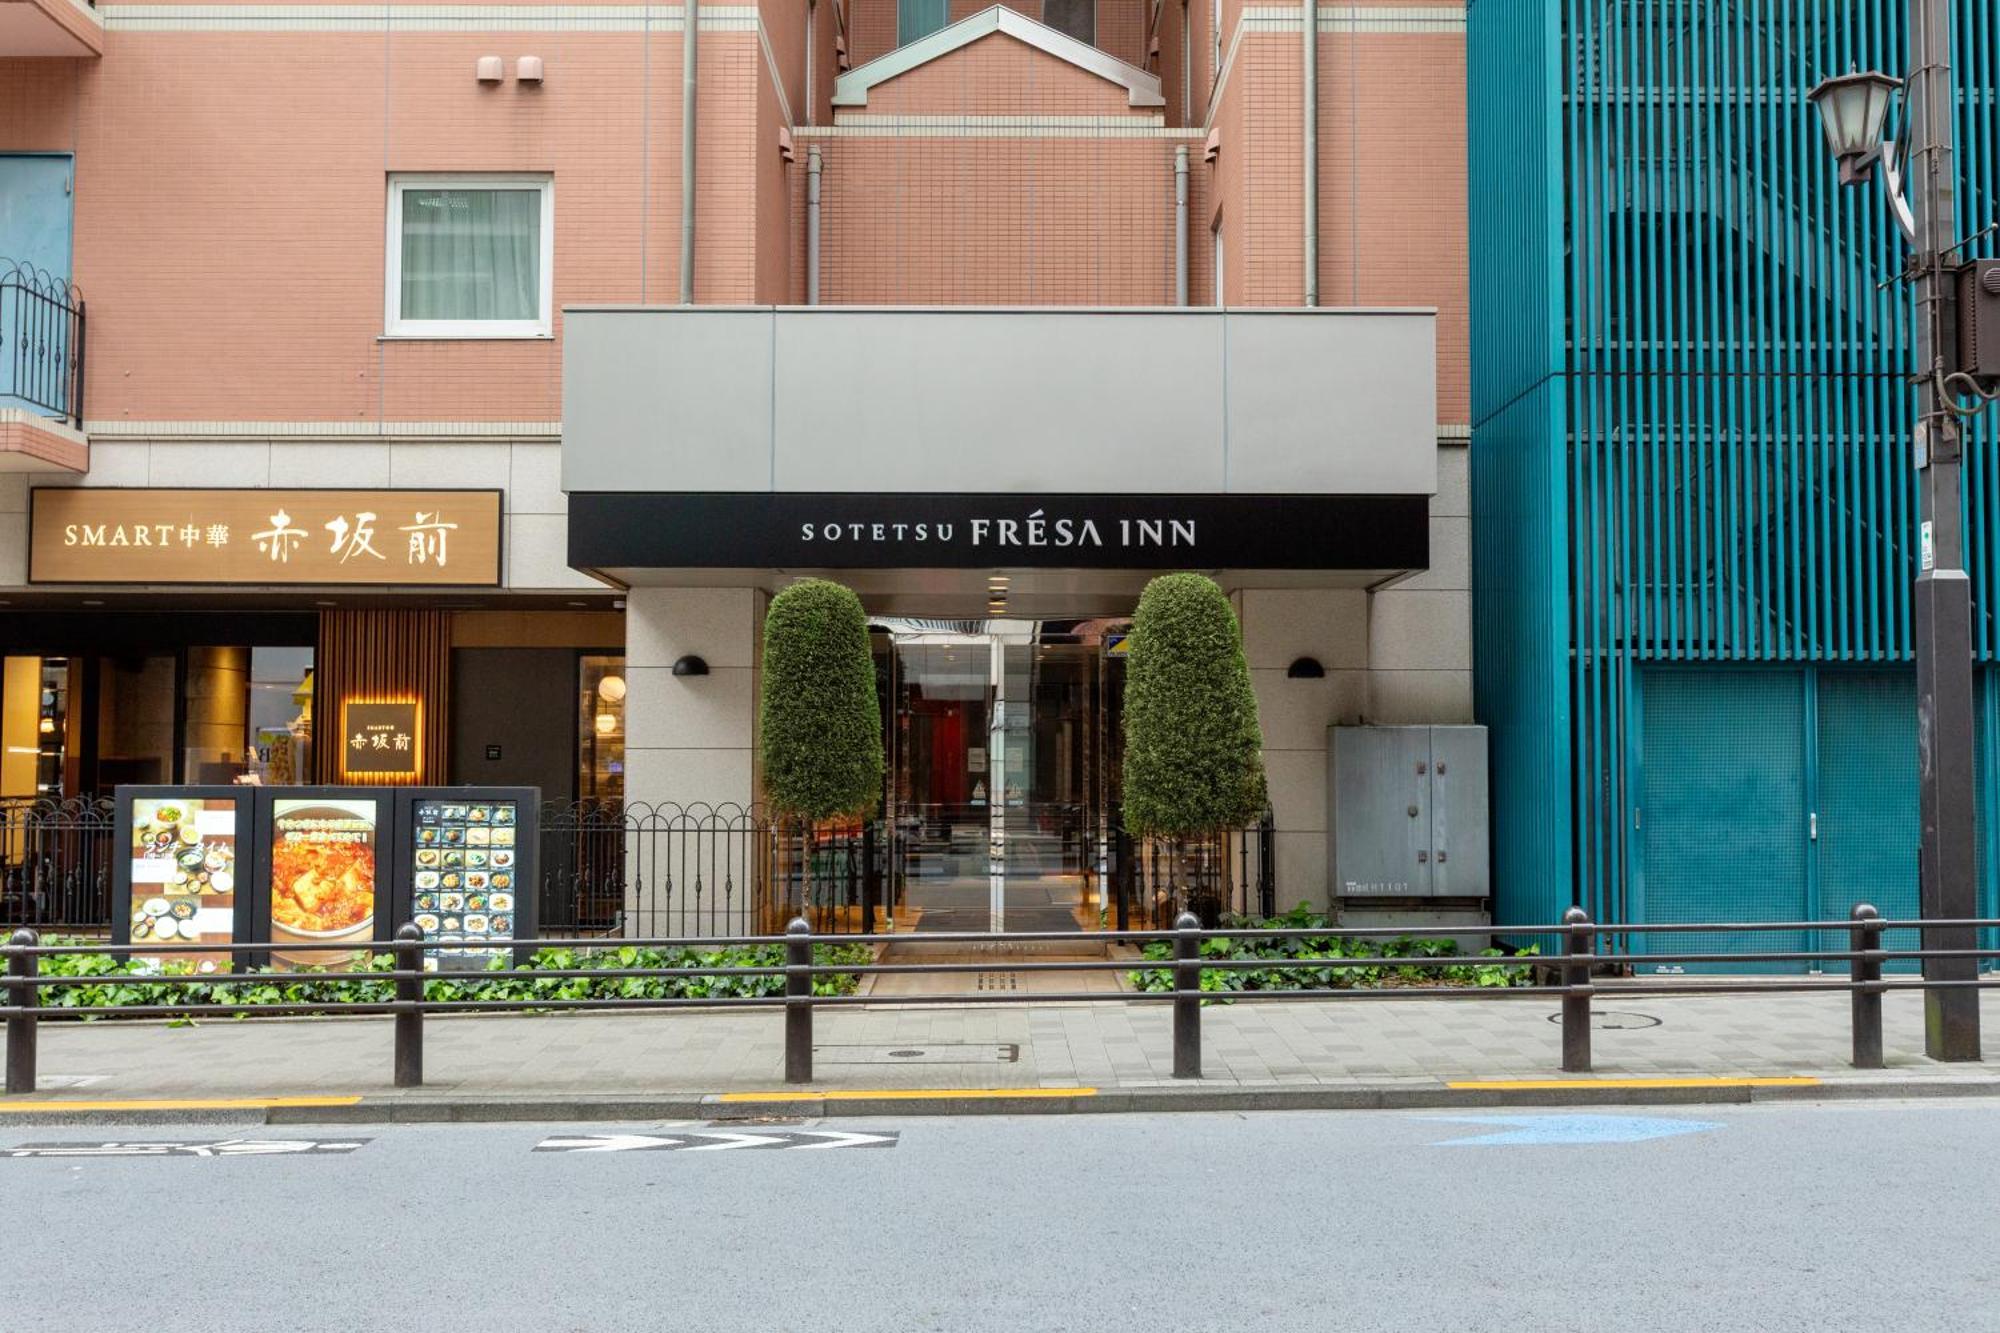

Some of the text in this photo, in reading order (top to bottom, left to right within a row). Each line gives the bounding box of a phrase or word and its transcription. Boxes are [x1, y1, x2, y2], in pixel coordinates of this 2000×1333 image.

[64, 508, 459, 567] SMART中華 赤坂前
[801, 509, 1196, 546] SOTETSU FRÉSA INN
[350, 732, 411, 751] 赤坂前
